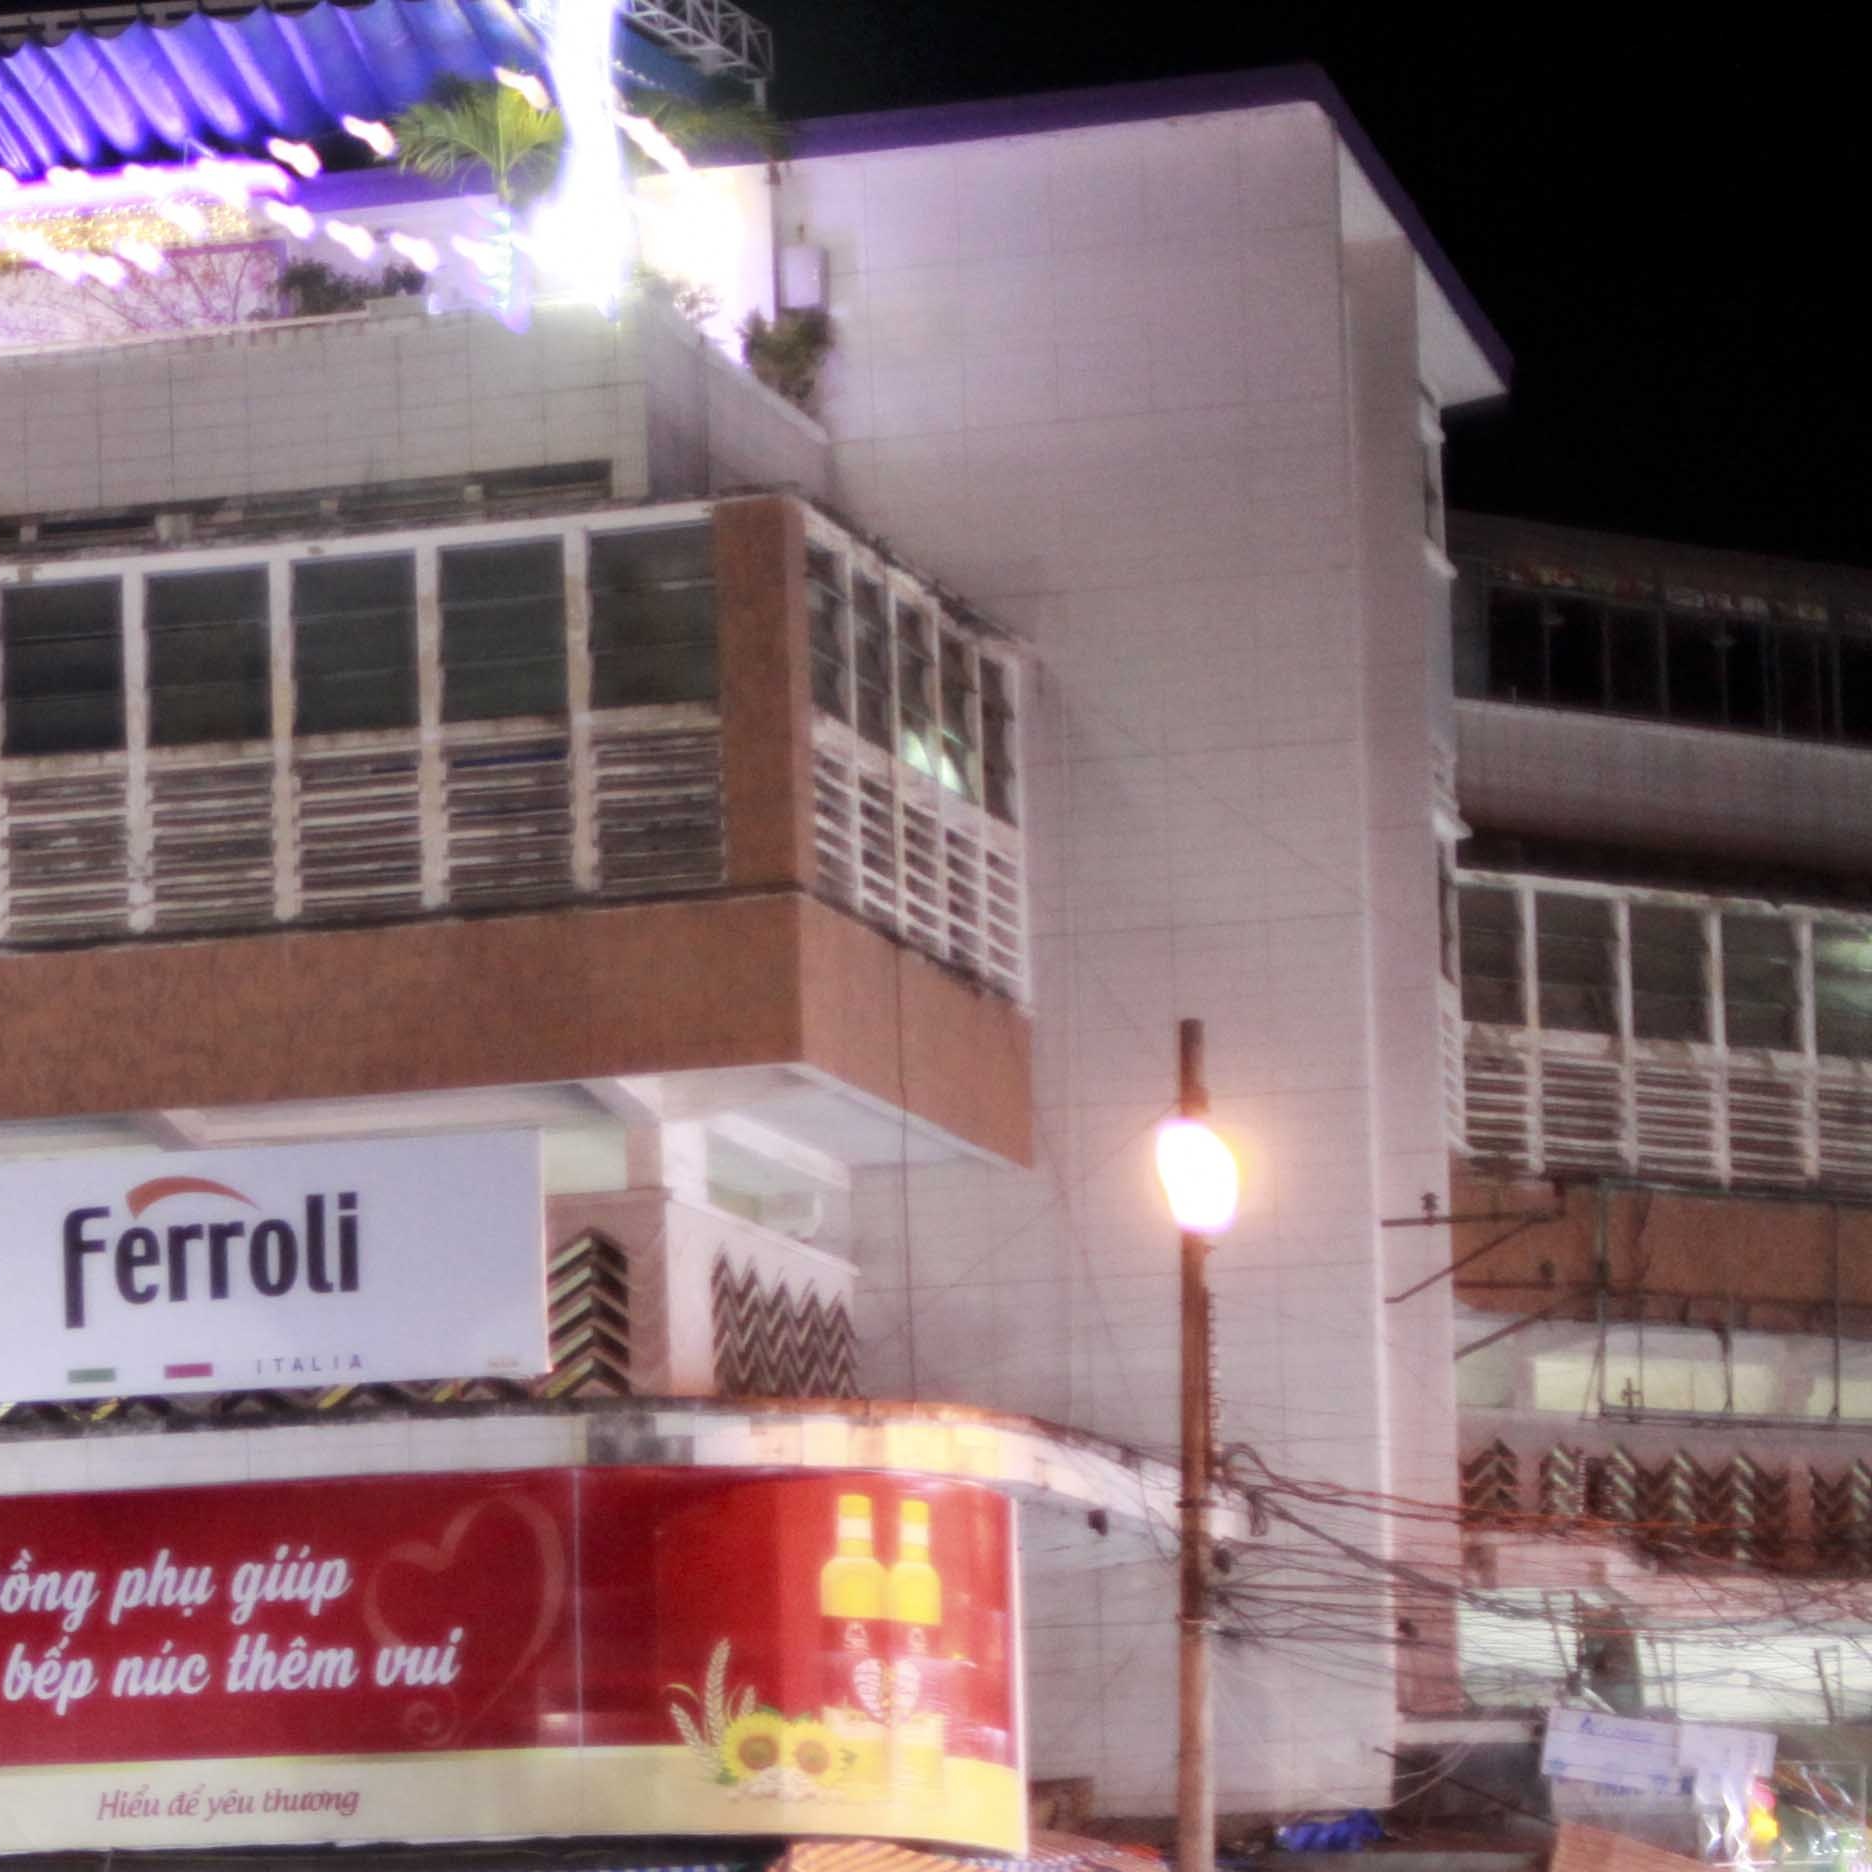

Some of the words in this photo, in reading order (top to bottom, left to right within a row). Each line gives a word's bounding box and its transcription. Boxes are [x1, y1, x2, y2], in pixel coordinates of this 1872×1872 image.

[62, 1191, 360, 1328] Ferroli
[256, 1354, 363, 1375] ITALIA
[109, 1547, 216, 1625] phụ
[232, 1543, 355, 1627] giúp
[2, 1635, 99, 1717] bếp
[112, 1639, 209, 1698] núc
[227, 1632, 360, 1694] thêm
[374, 1627, 464, 1687] vui
[97, 1784, 160, 1822] Hiểu
[166, 1785, 201, 1818] để
[205, 1791, 256, 1826] yêu
[261, 1787, 360, 1818] thương
